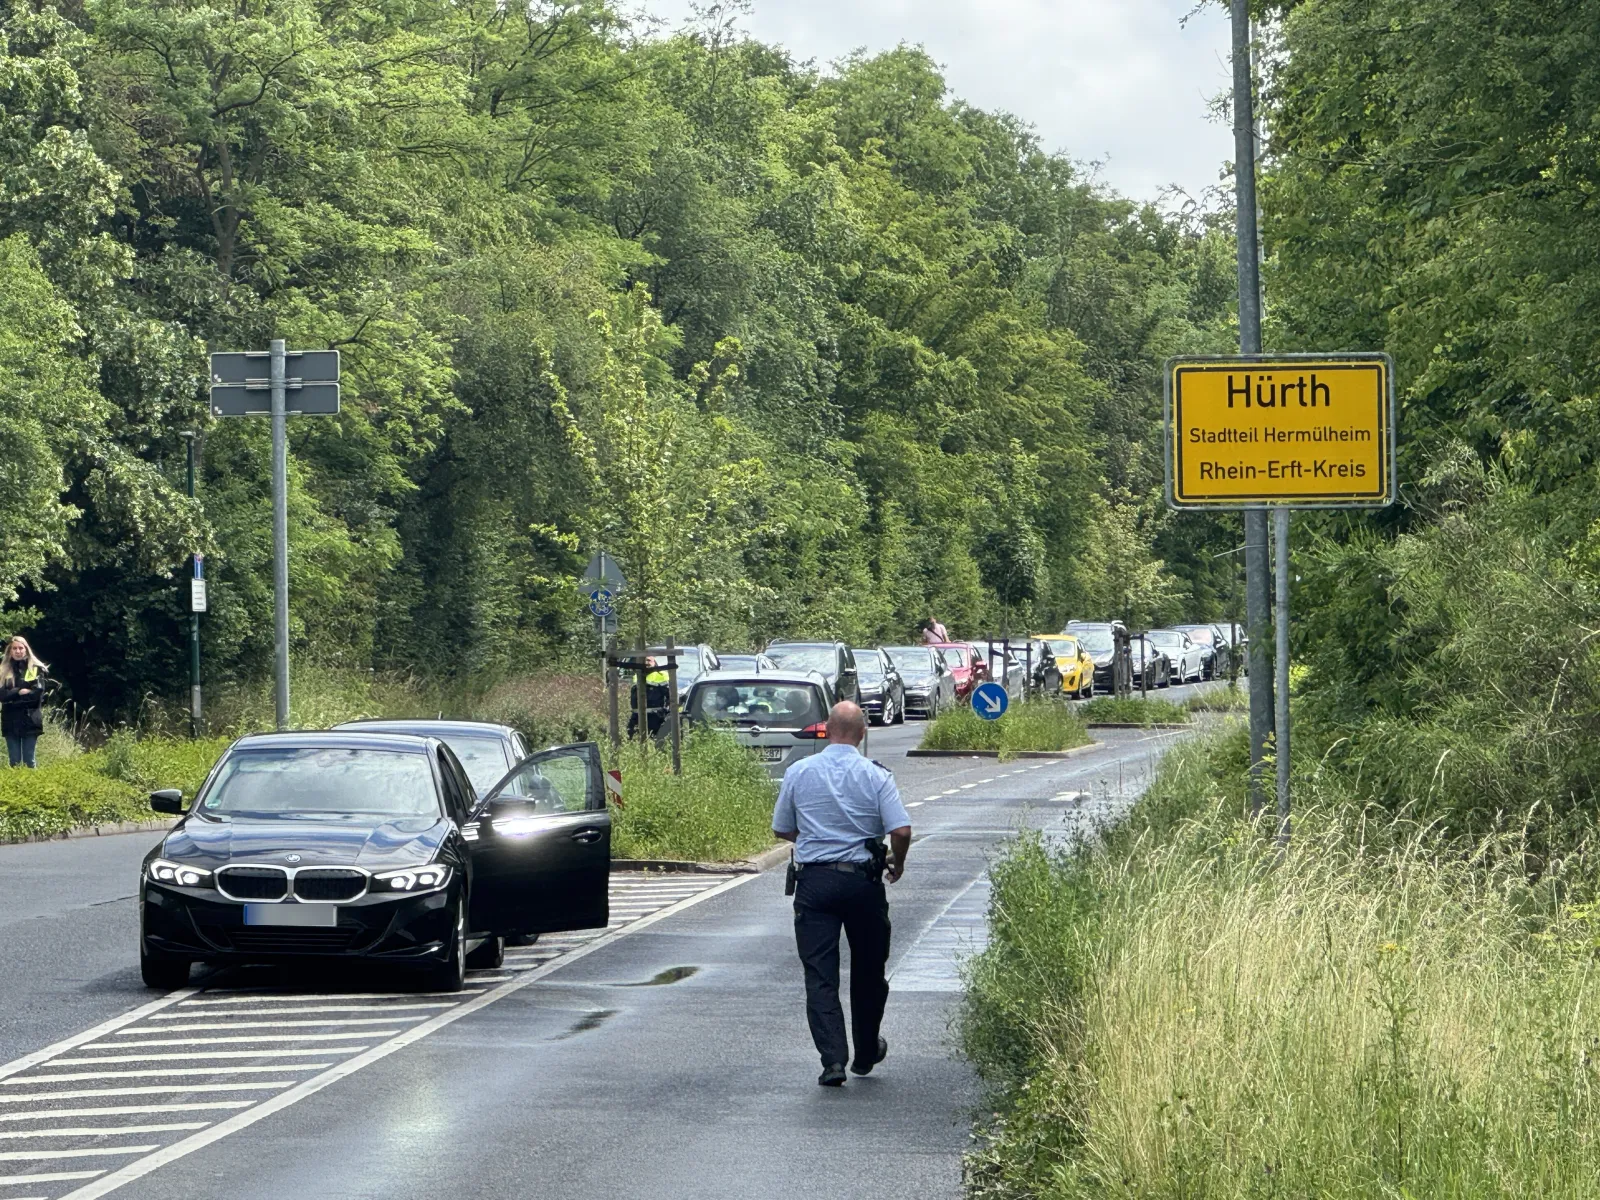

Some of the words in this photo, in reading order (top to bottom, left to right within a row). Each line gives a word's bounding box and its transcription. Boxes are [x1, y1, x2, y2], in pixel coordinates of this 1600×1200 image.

[1227, 374, 1330, 408] Hürth
[1190, 428, 1258, 443] Stadtteil
[1264, 426, 1371, 442] Hermülheim
[1200, 459, 1366, 480] Rhein-Erft-Kreis
